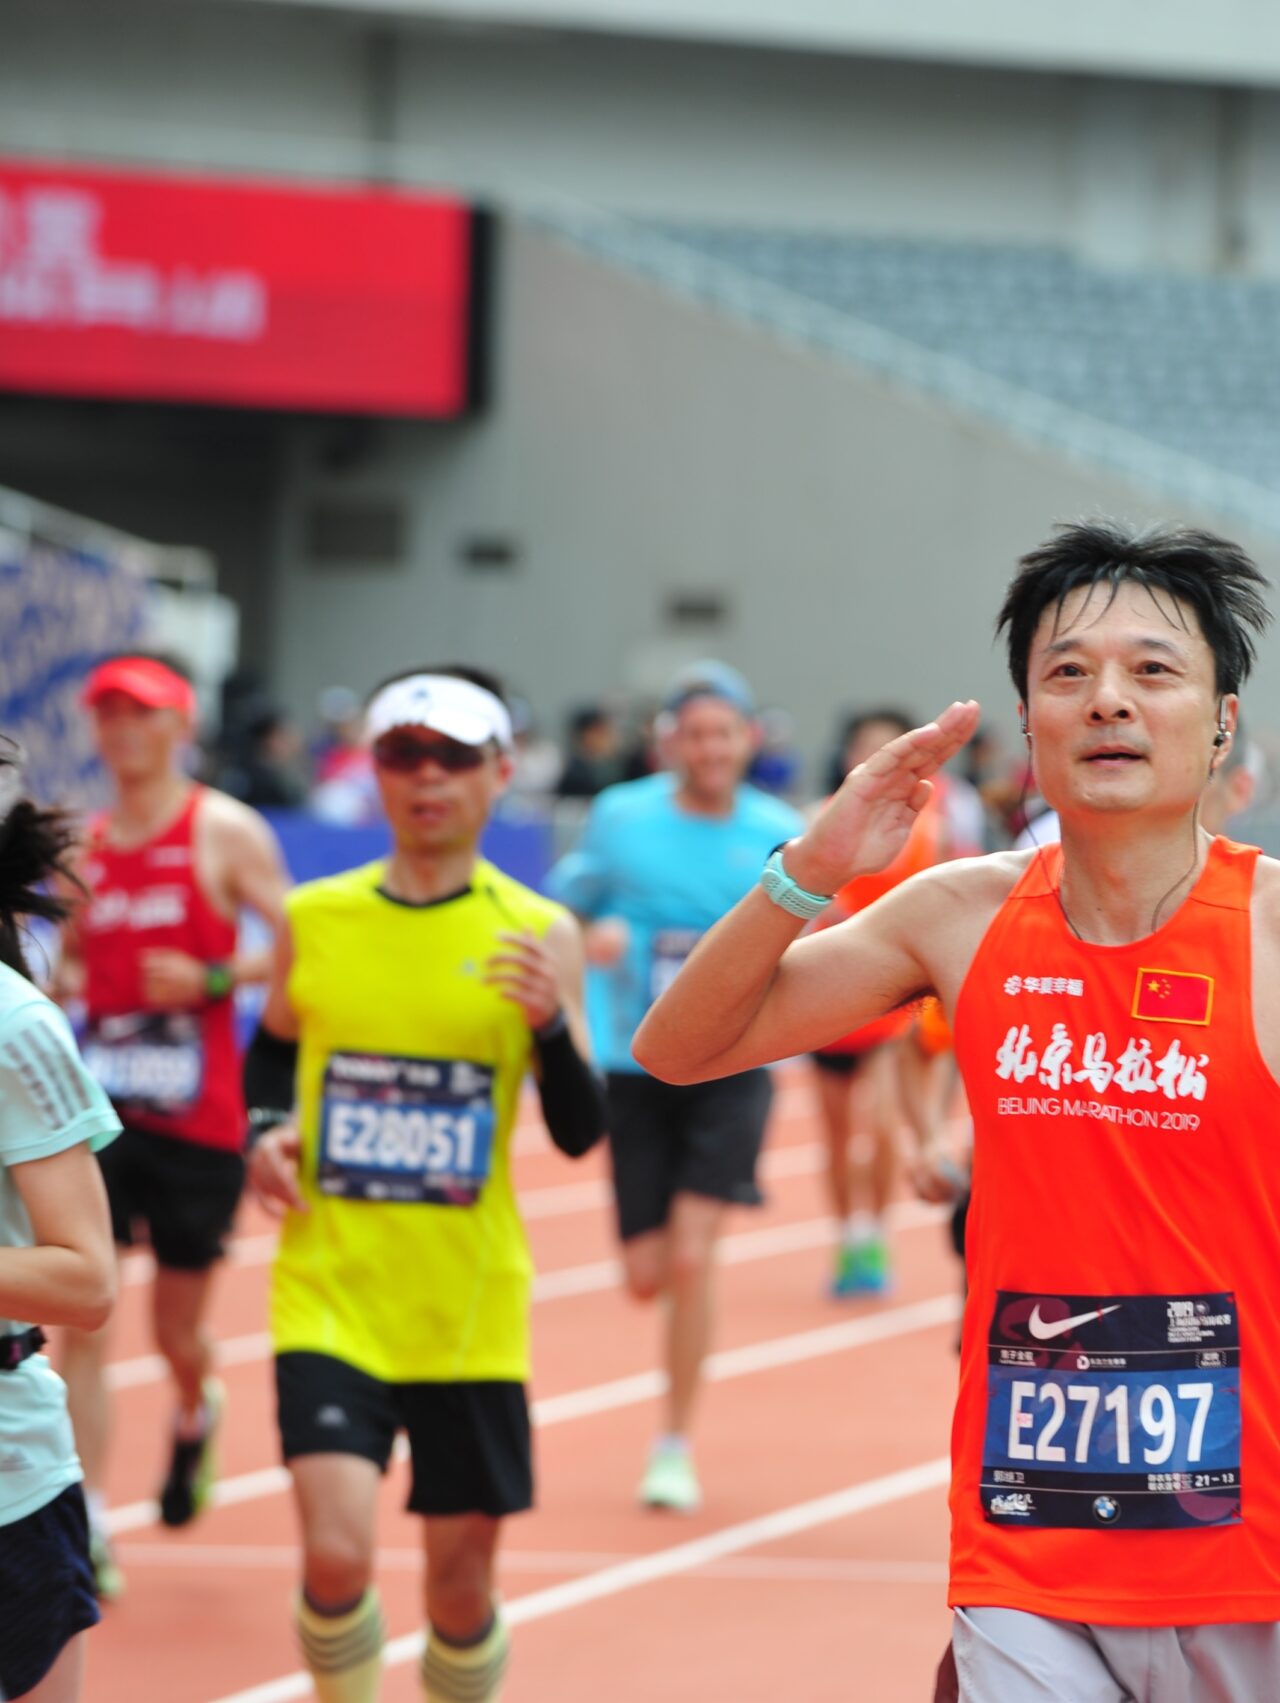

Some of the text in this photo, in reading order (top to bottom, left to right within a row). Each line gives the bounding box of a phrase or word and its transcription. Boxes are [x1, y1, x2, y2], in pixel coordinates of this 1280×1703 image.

[995, 1023, 1209, 1101] 北京马拉松
[328, 1104, 476, 1173] E28051
[997, 1097, 1201, 1132] BEIJING MARATHON 2019
[1007, 1381, 1214, 1465] E27197
